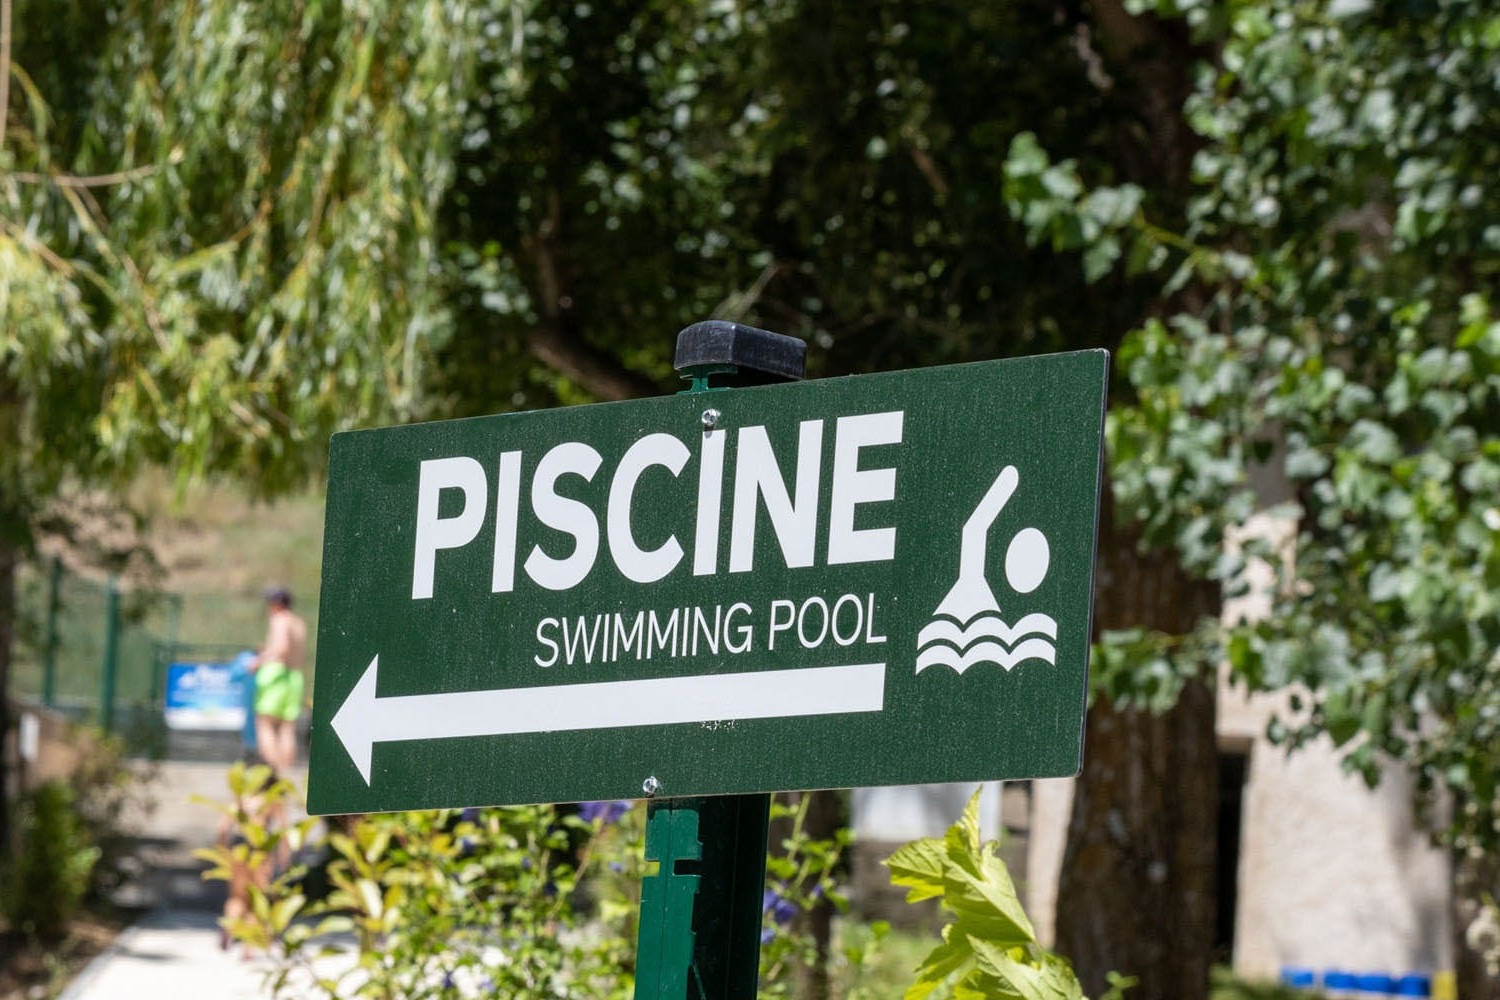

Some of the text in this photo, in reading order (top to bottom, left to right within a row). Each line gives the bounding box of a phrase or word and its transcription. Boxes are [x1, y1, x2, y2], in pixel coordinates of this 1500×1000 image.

[411, 410, 905, 600] PISCINE
[533, 592, 888, 668] SWIMMING POOL
